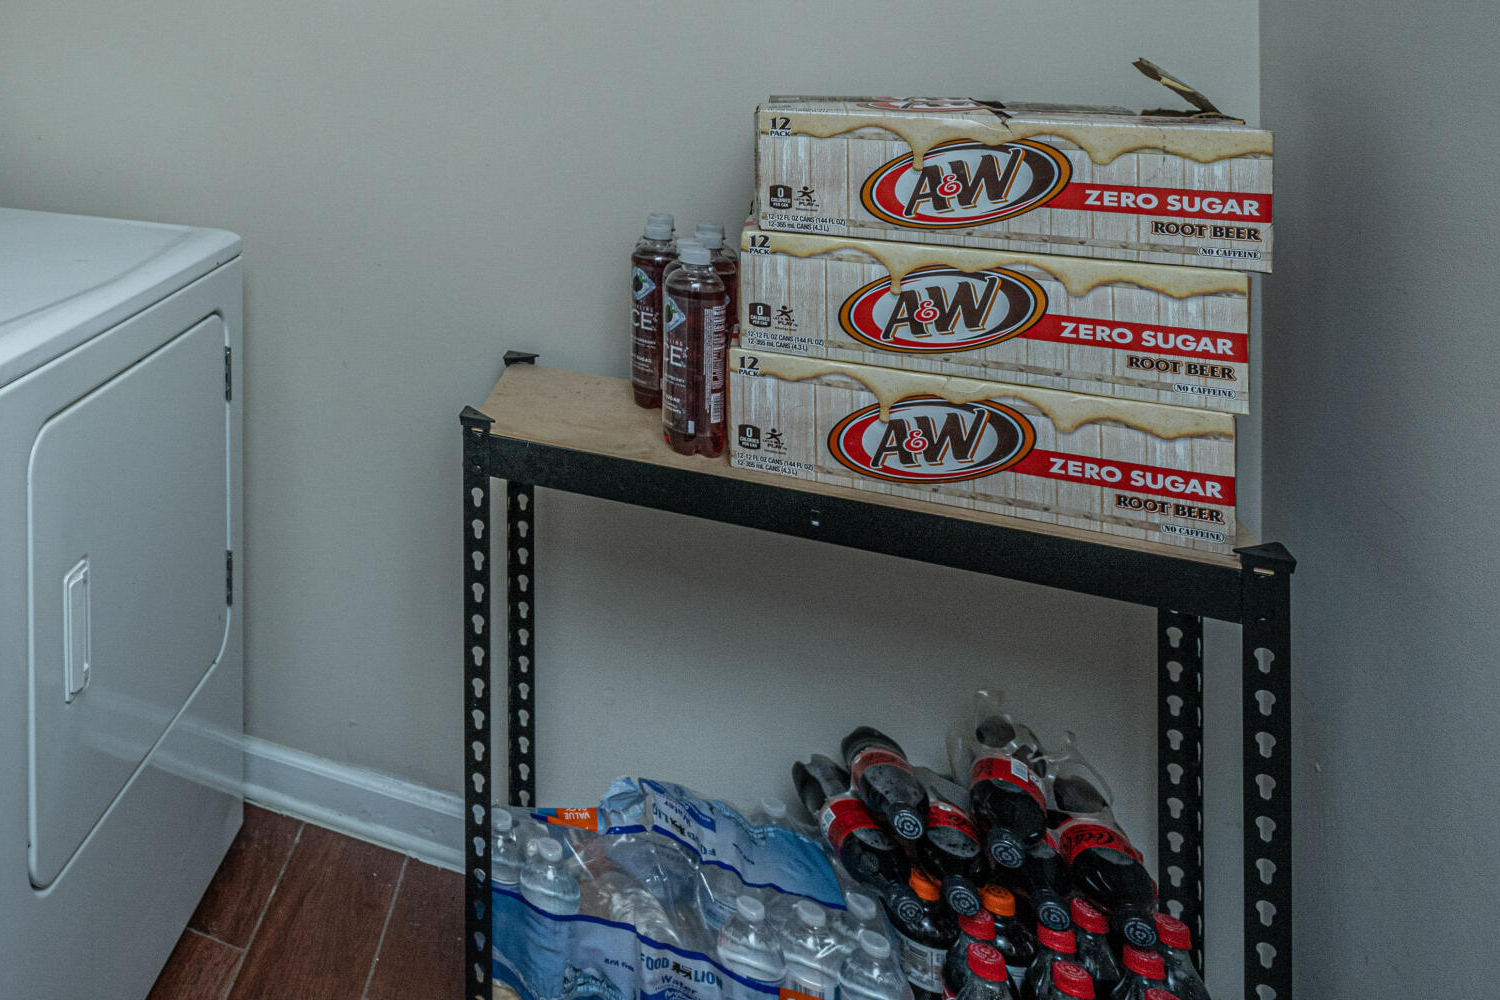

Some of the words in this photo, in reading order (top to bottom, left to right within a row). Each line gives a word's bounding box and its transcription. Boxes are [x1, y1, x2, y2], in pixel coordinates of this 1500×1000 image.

[770, 117, 792, 131] 12
[770, 130, 791, 138] PACK
[902, 148, 1026, 219] A&W
[1084, 189, 1158, 210] ZERO
[1166, 196, 1261, 217] SUGAR
[750, 234, 771, 248] 12
[1151, 221, 1208, 239] ROOT
[1210, 224, 1262, 242] BEER
[1201, 248, 1214, 256] NO
[1215, 248, 1260, 260] CAFFEINE
[880, 276, 1002, 342] A&W
[1060, 321, 1133, 344] ZERO
[1141, 331, 1234, 356] SUGAR
[738, 356, 760, 370] 12
[738, 369, 760, 377] PACK
[1127, 355, 1183, 375] ROOT
[1185, 362, 1236, 382] BEER
[1176, 384, 1189, 393] NO
[1190, 386, 1235, 399] CAFFEINE
[870, 408, 991, 469] A&W
[1048, 458, 1122, 484] ZERO
[1130, 470, 1224, 499] SUGAR
[1116, 494, 1171, 516] ROOT
[1172, 502, 1226, 525] BEER
[1164, 524, 1177, 534] NO
[1178, 526, 1223, 542] CAFFEINE
[640, 952, 670, 970] FOOD
[661, 974, 700, 996] Water
